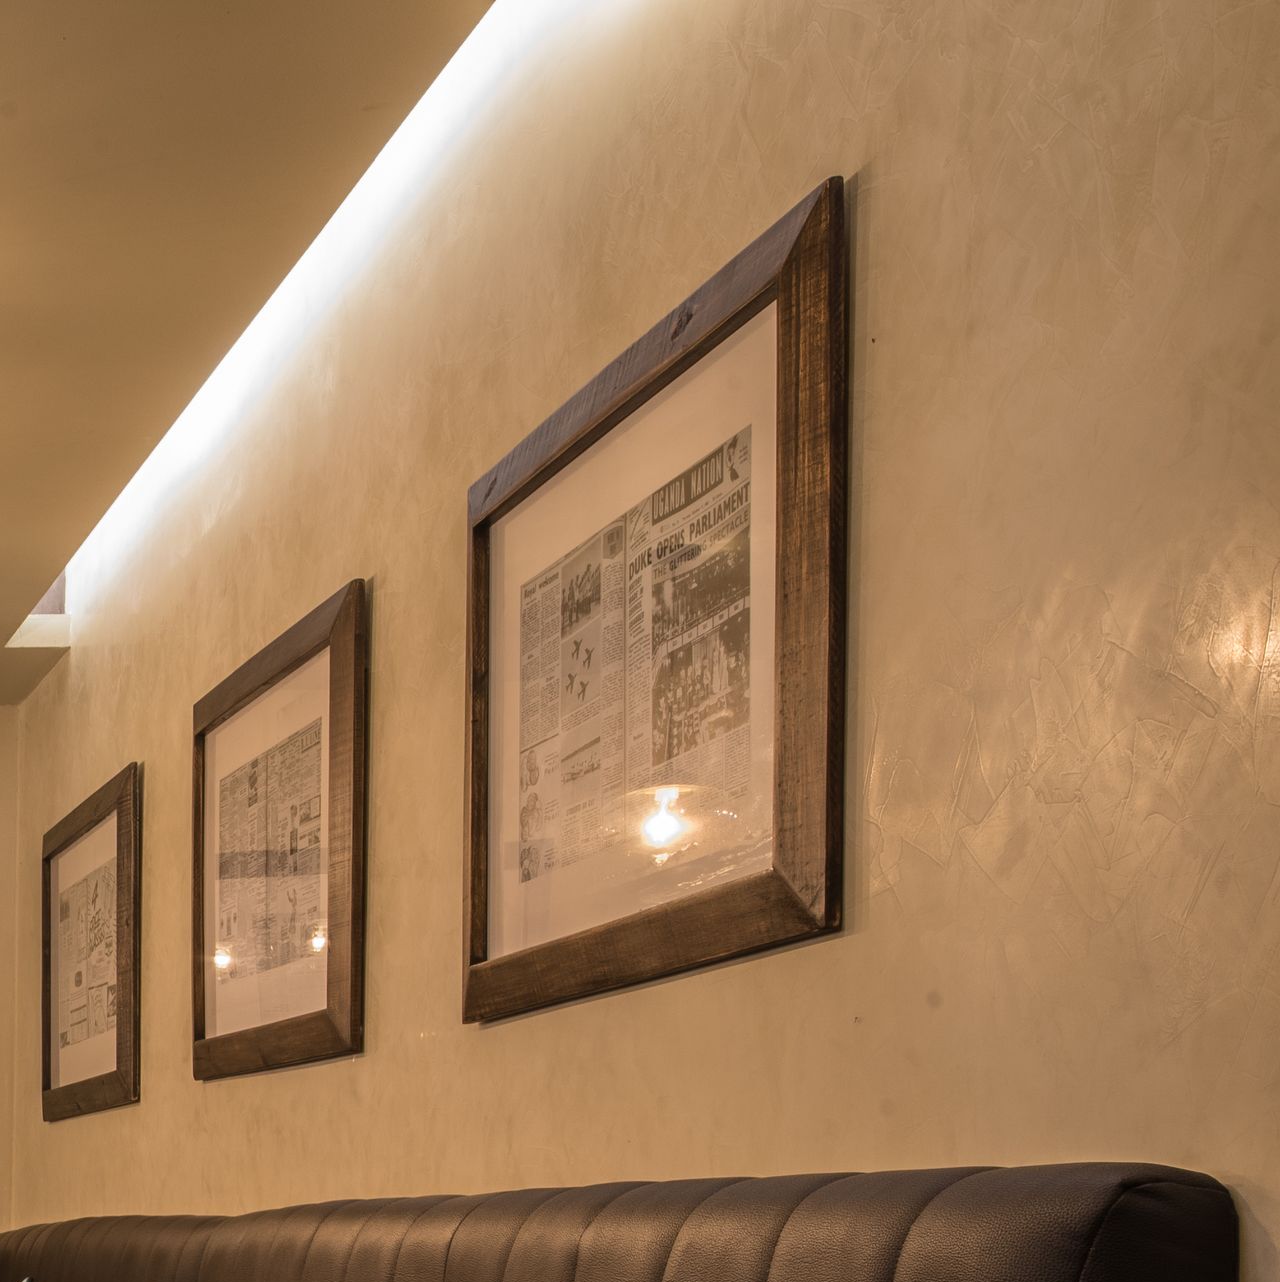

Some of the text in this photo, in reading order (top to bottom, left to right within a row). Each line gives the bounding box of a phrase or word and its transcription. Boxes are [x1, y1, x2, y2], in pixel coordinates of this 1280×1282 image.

[653, 478, 686, 521] UGANDA
[690, 450, 723, 501] NATION
[628, 546, 652, 581] DUKE
[656, 529, 685, 560] OPENS
[689, 481, 751, 542] PARLIAMENT
[653, 562, 667, 580] THE
[668, 542, 708, 572] GLITTERING
[709, 509, 749, 548] SPECTACLE
